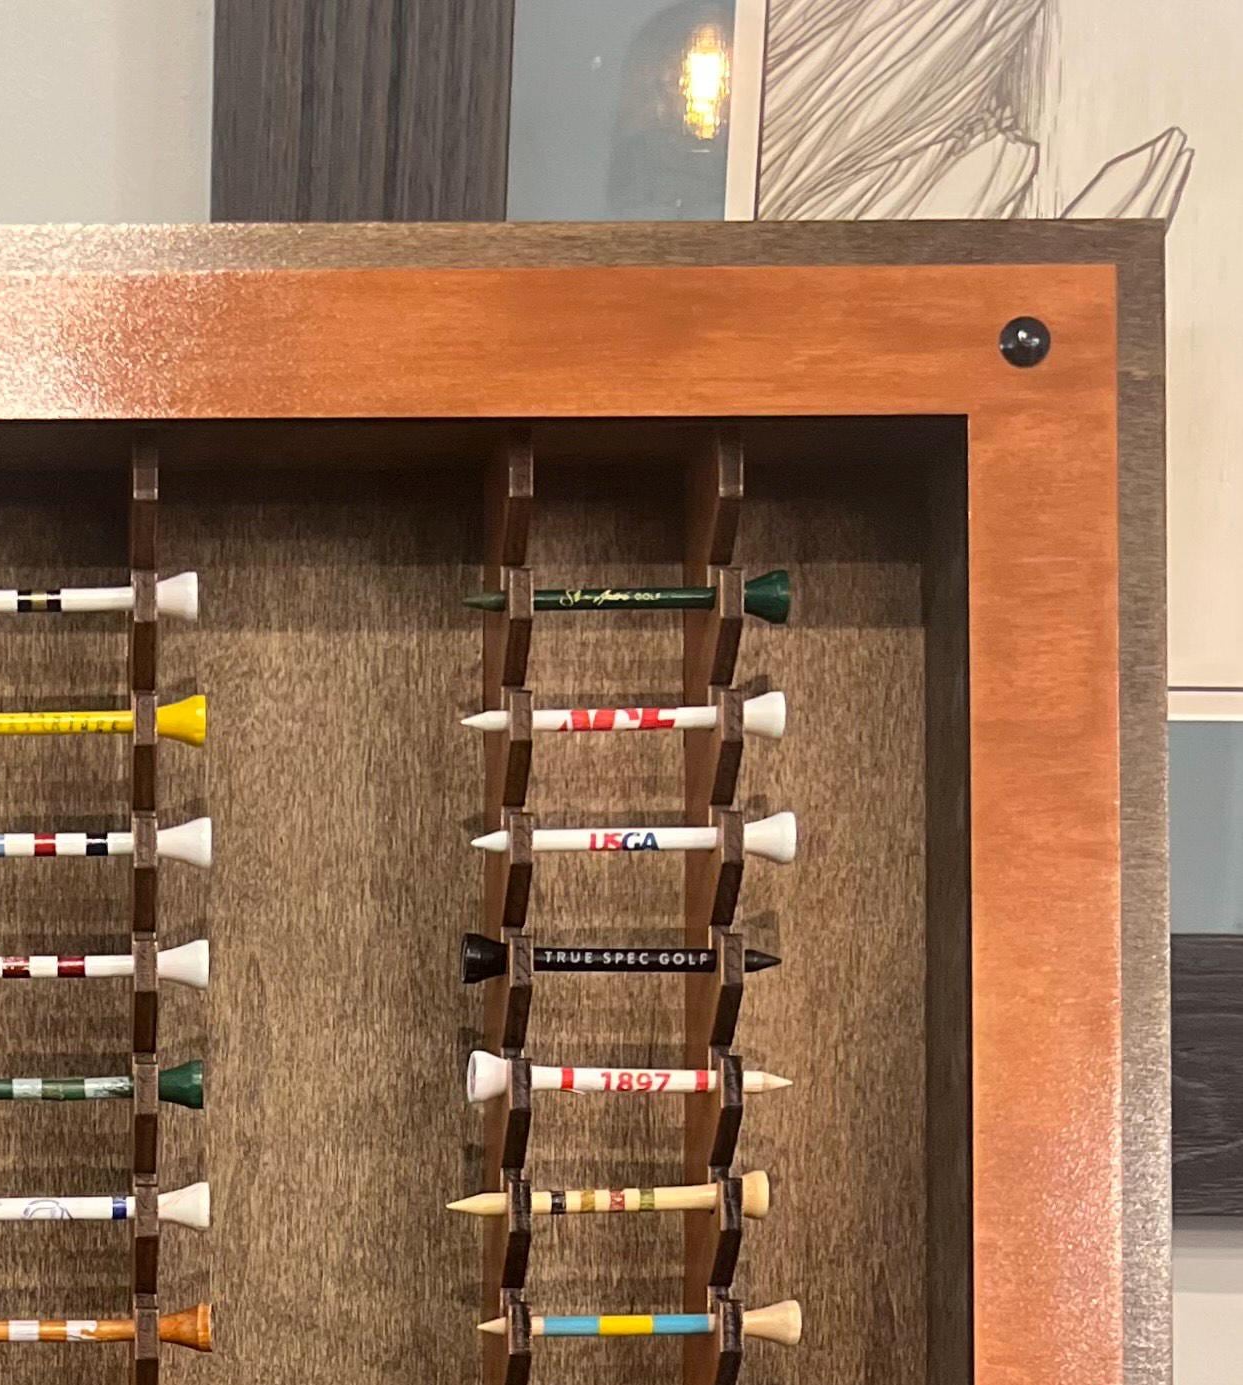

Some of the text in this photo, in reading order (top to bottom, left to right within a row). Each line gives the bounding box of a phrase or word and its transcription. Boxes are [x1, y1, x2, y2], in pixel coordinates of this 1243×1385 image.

[589, 831, 660, 851] USGA
[544, 951, 709, 966] TRUE SPEC GOLF
[600, 1071, 672, 1093] 1897
